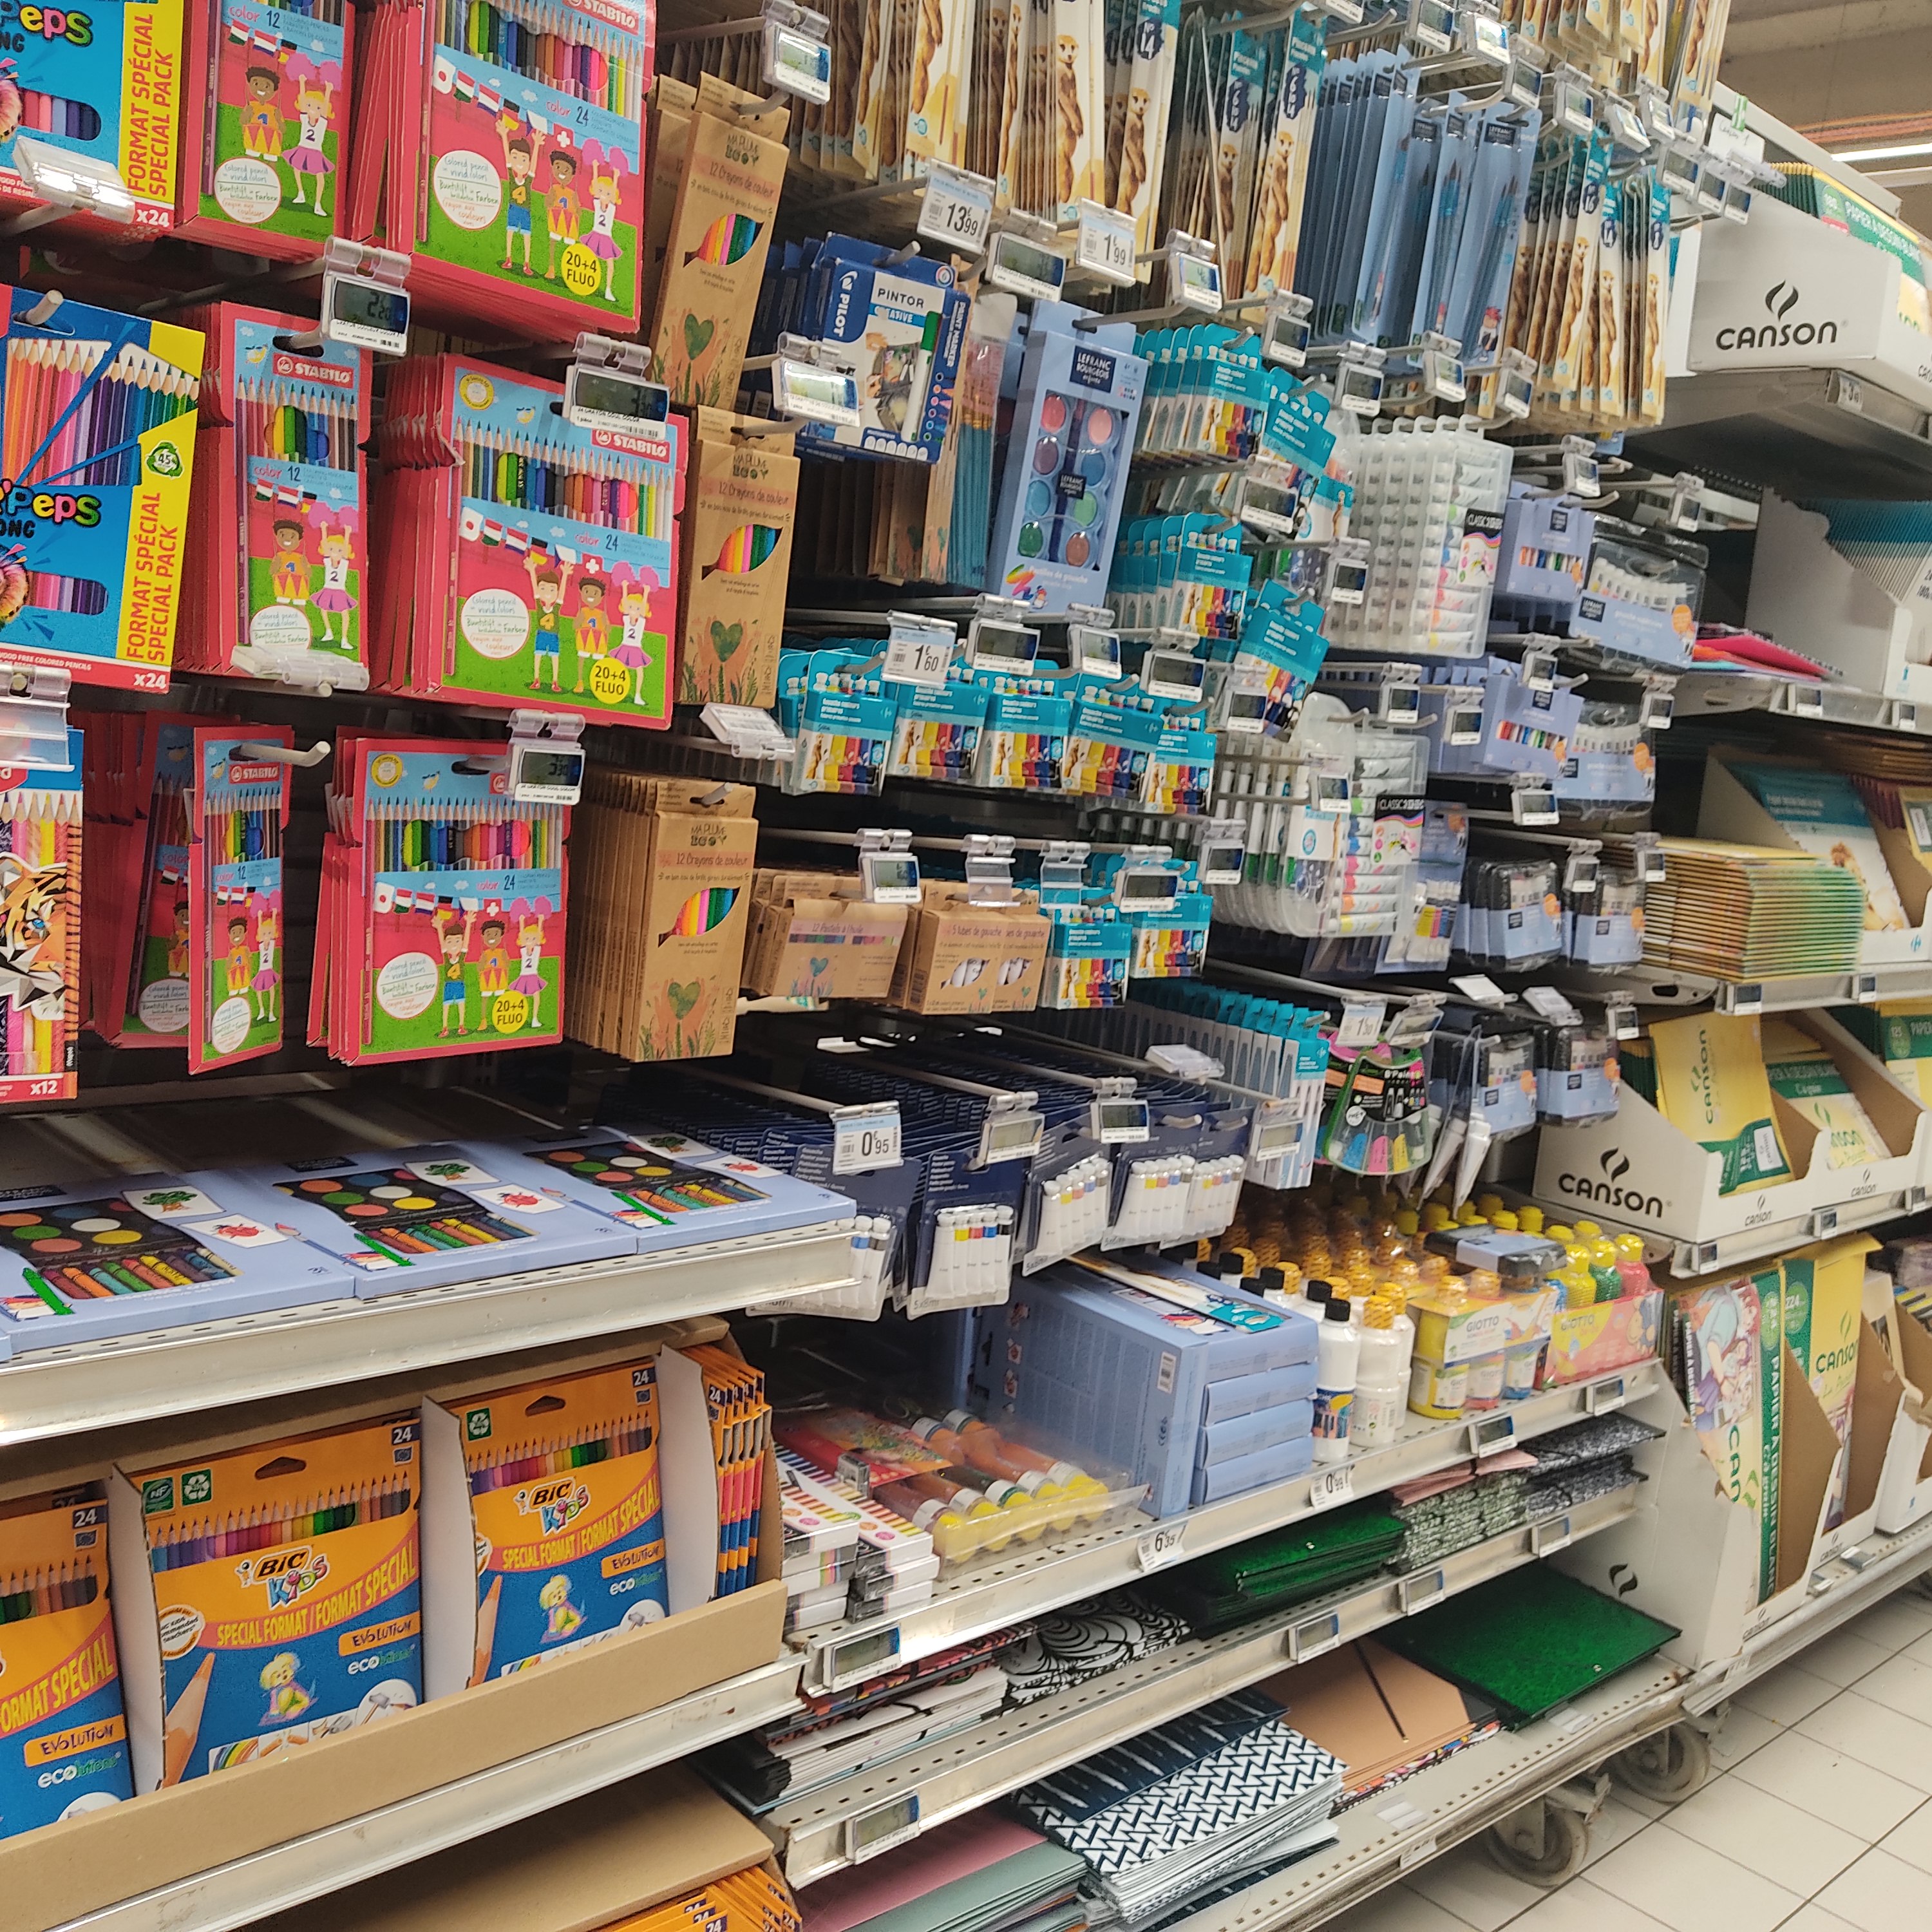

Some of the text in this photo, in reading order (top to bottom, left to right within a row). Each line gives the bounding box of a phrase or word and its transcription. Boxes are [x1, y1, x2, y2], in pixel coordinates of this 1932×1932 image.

[229, 5, 260, 22] color
[266, 10, 280, 29] 12
[1140, 33, 1154, 60] 14
[128, 14, 153, 192] FORMAT SPÉCIAL
[546, 100, 589, 126] color 24
[149, 49, 173, 196] SPECIAL PACK
[306, 129, 316, 142] 2
[512, 188, 526, 205] 4
[136, 209, 170, 227] x24
[598, 215, 606, 227] 2
[566, 251, 597, 272] 20+4
[567, 269, 595, 287] FLUO
[878, 288, 925, 309] PINTOR
[833, 294, 851, 337] PILOT
[1716, 321, 1837, 350] CANSON
[1077, 352, 1112, 371] LEFRANC
[295, 363, 350, 383] STABILO
[1076, 363, 1110, 380] BOURGEOIS
[613, 433, 667, 457] STABILO
[254, 465, 282, 478] color
[287, 466, 301, 482] 12
[719, 482, 728, 495] 12
[728, 484, 755, 500] Crayons
[575, 531, 600, 545] color
[605, 534, 618, 552] 24
[127, 492, 161, 658] FORMAT SPÉCIAL
[330, 571, 339, 582] 2
[147, 526, 178, 662] SPECIAL PACK
[539, 612, 555, 630] 4
[628, 628, 636, 639] 2
[35, 656, 62, 667] COLORED
[133, 672, 167, 689] x24
[595, 665, 627, 682] 20+4
[595, 681, 624, 696] FLUO
[676, 853, 748, 868] 12 Crayons de couleur
[216, 866, 246, 882] color 12
[476, 879, 499, 891] color
[504, 875, 515, 891] 24
[263, 953, 270, 963] 2
[525, 958, 533, 968] 2
[497, 999, 524, 1012] 20+4
[497, 1013, 523, 1025] FLUO
[1699, 1029, 1714, 1124] CANSON
[30, 1081, 57, 1096] x12
[1558, 1173, 1663, 1218] CANSON
[1466, 1315, 1500, 1333] GIOTTO
[1560, 1314, 1595, 1331] GIOTTO
[634, 1370, 649, 1385] 24
[709, 1387, 721, 1403] 24
[394, 1426, 413, 1444] 24
[1768, 1356, 1780, 1596] PAPIER DESSIN BLANC
[74, 1509, 98, 1528] 24
[502, 1475, 660, 1570] SPECIAL FORMAT FORMAT SPECIAL
[611, 1546, 659, 1570] EVOLUTION
[216, 1622, 261, 1647] SPECIAL
[263, 1609, 308, 1643] FORMAT
[316, 1583, 363, 1629] FORMAT
[365, 1539, 417, 1607] SPECIAL
[351, 1619, 412, 1647] EVOLUTION
[52, 1633, 114, 1710] SPECIAL
[40, 1724, 114, 1756] EVOLUTION
[706, 1919, 722, 1932] 24
